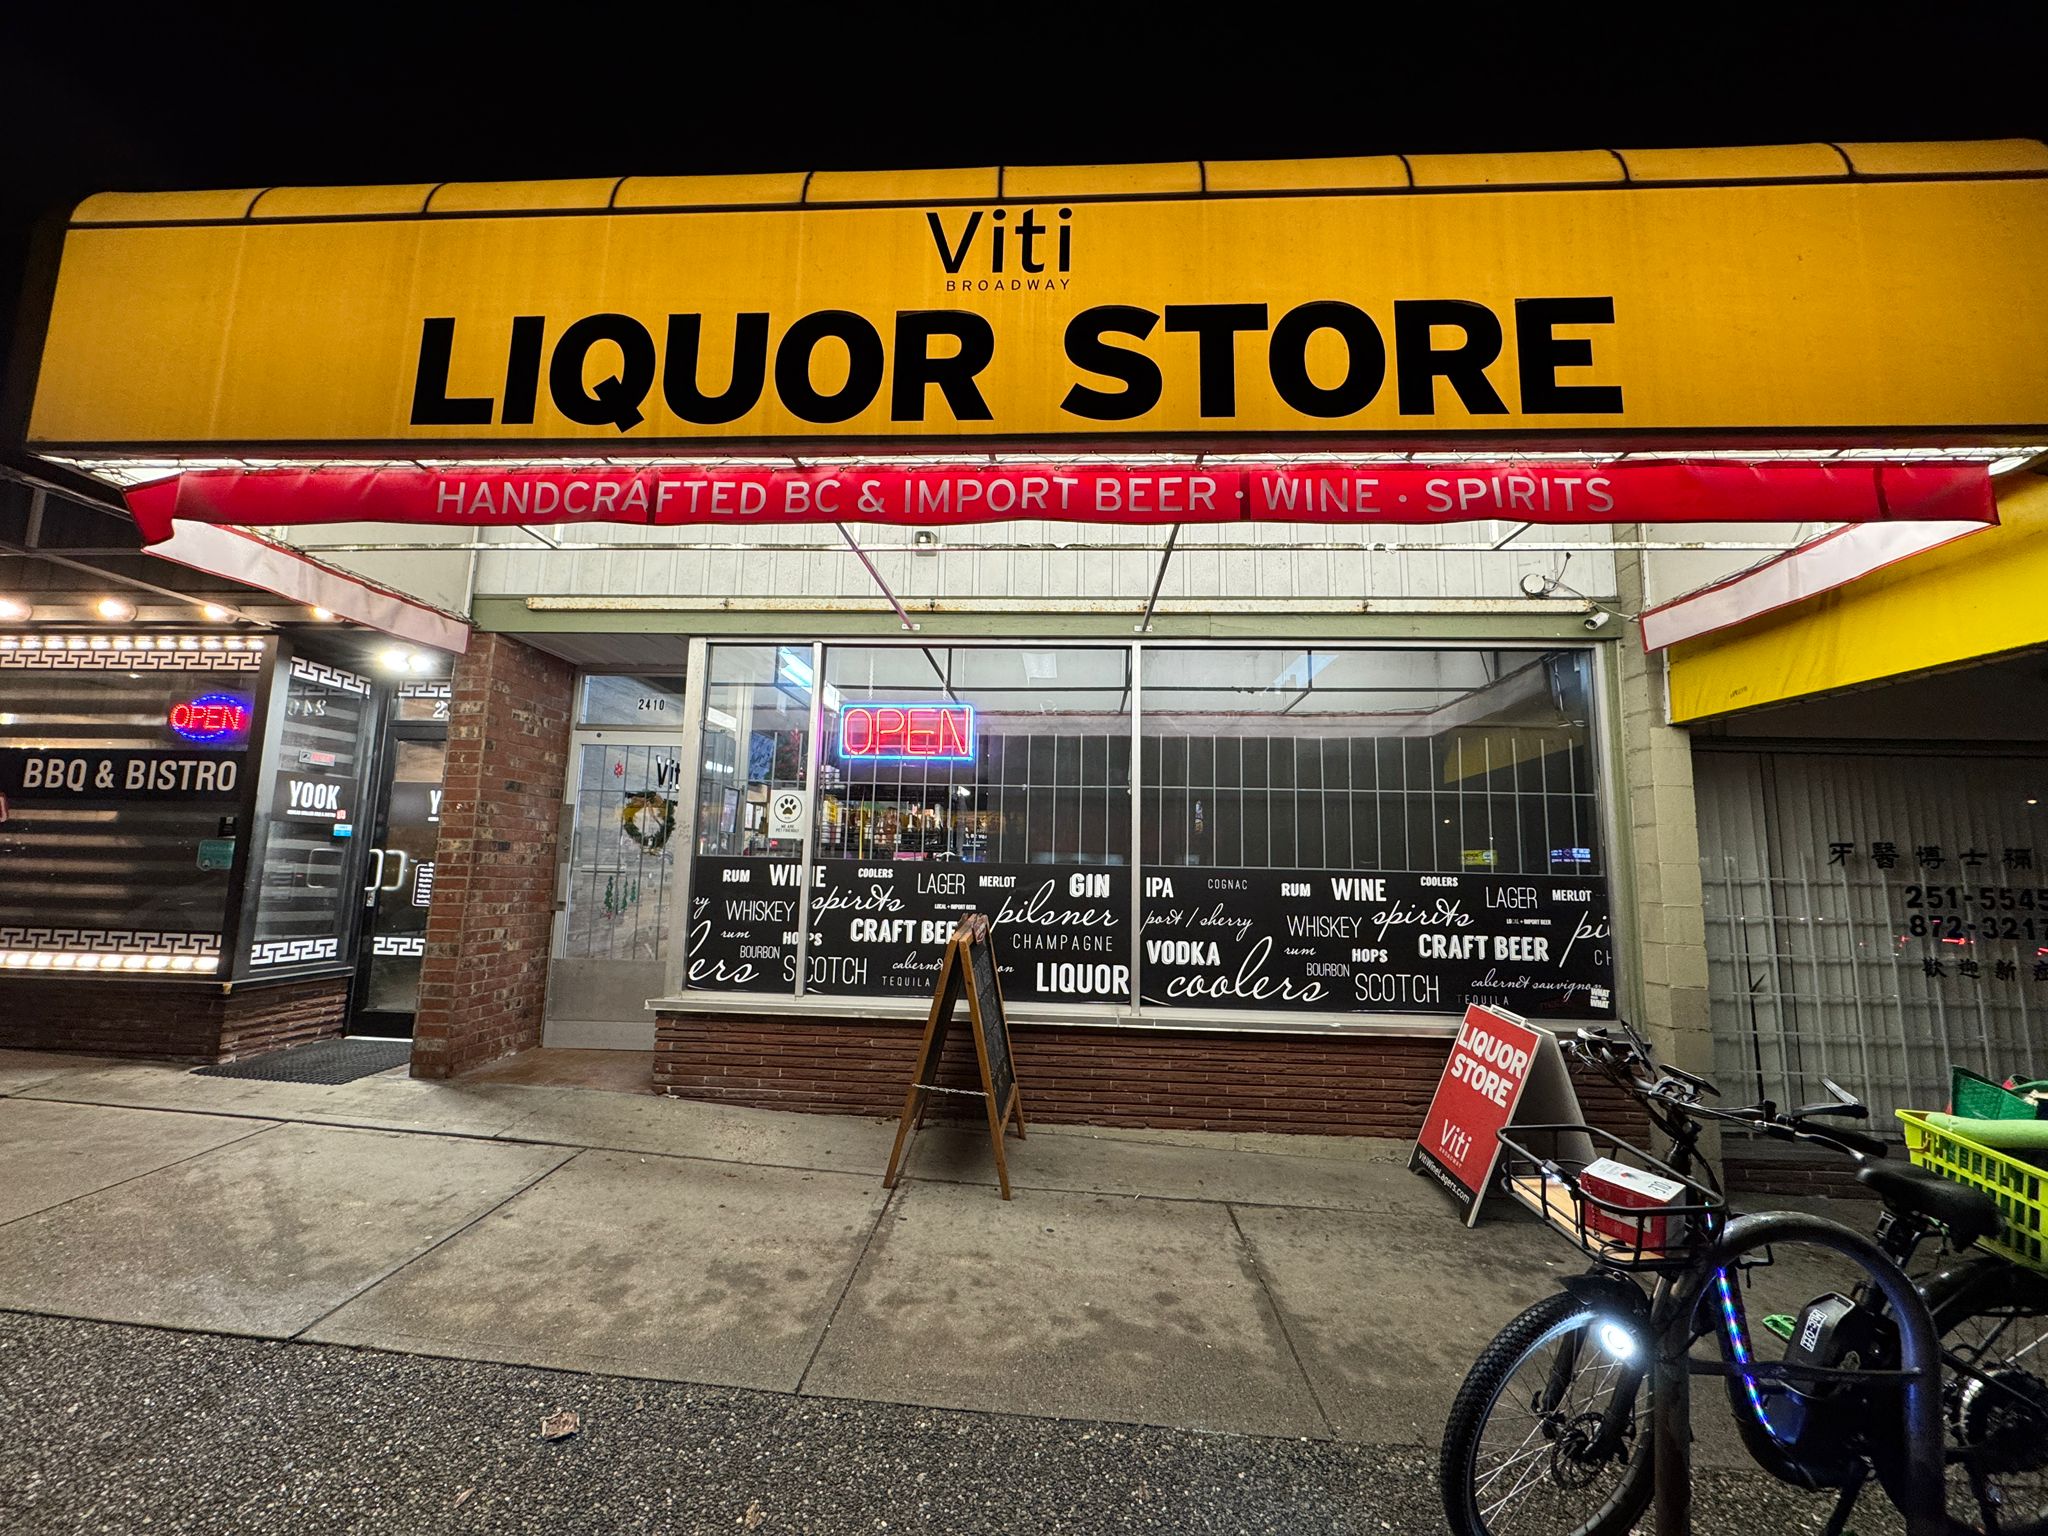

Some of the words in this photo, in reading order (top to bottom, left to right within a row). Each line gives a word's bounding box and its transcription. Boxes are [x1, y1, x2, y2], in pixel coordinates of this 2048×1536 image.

[926, 207, 1071, 274] Viti
[946, 279, 1071, 292] BROADWAY
[410, 309, 995, 433] LIQUOR
[1060, 296, 1624, 421] STORE
[437, 479, 766, 516] HANDCRAFTED
[785, 479, 841, 515] BC
[857, 480, 885, 514] &
[902, 478, 1078, 514] IMPORT
[1096, 477, 1216, 513] BEER
[1262, 477, 1381, 514] WINE
[1426, 476, 1615, 513] SPIRITS
[171, 702, 243, 730] OPEN
[637, 698, 665, 711] 2410
[843, 708, 970, 755] OPEN
[23, 758, 87, 792] BBQ
[95, 759, 114, 789] &
[125, 760, 238, 792] BISTRO
[289, 780, 341, 811] YOOK
[723, 869, 750, 883] RUM
[858, 868, 894, 879] COOLERS
[917, 873, 966, 895] LAGER
[979, 876, 1016, 888] MERLOT
[1207, 878, 1248, 890] COGNAC
[1420, 876, 1459, 887] COOLERS
[1069, 873, 1110, 898] GIN
[1145, 877, 1174, 898] IPA
[1281, 883, 1311, 897] RUM
[1331, 878, 1387, 902] WINE
[1552, 889, 1592, 902] MERLOT
[811, 884, 905, 926] spirits
[989, 879, 1119, 933] pilsner
[1485, 886, 1538, 909] LAGER
[1905, 885, 2048, 910] 251-5545
[725, 900, 795, 922] WHISKEY
[1140, 909, 1184, 935] port
[1200, 902, 1253, 942] sherry
[1371, 898, 1474, 942] spirits
[721, 930, 751, 939] rum
[850, 918, 916, 944] CRAFT
[921, 918, 958, 944] BEE
[1286, 915, 1362, 938] WHISKEY
[740, 945, 780, 959] BOURBON
[1012, 933, 1113, 952] CHAMPAGNE
[1146, 940, 1221, 966] VODKA
[1284, 946, 1316, 956] rum
[1418, 934, 1489, 960] CRAFT
[1494, 935, 1550, 962] BEER
[1352, 948, 1388, 963] HOPS
[1036, 962, 1129, 995] LIQUOR
[1167, 935, 1329, 1002] coolers
[1306, 962, 1350, 977] BOURBON
[1471, 968, 1532, 989] cabernet
[881, 975, 931, 987] TEQUILA
[1355, 972, 1440, 1004] SCOTCH
[1590, 987, 1610, 998] WHAT
[1456, 994, 1509, 1007] TEQUILA
[1590, 998, 1610, 1009] WHAT
[1458, 1023, 1528, 1079] LIQUOR
[1451, 1053, 1513, 1108] STORE
[1440, 1119, 1472, 1162] Viti
[1418, 1150, 1470, 1204] VitiWineLagers.com
